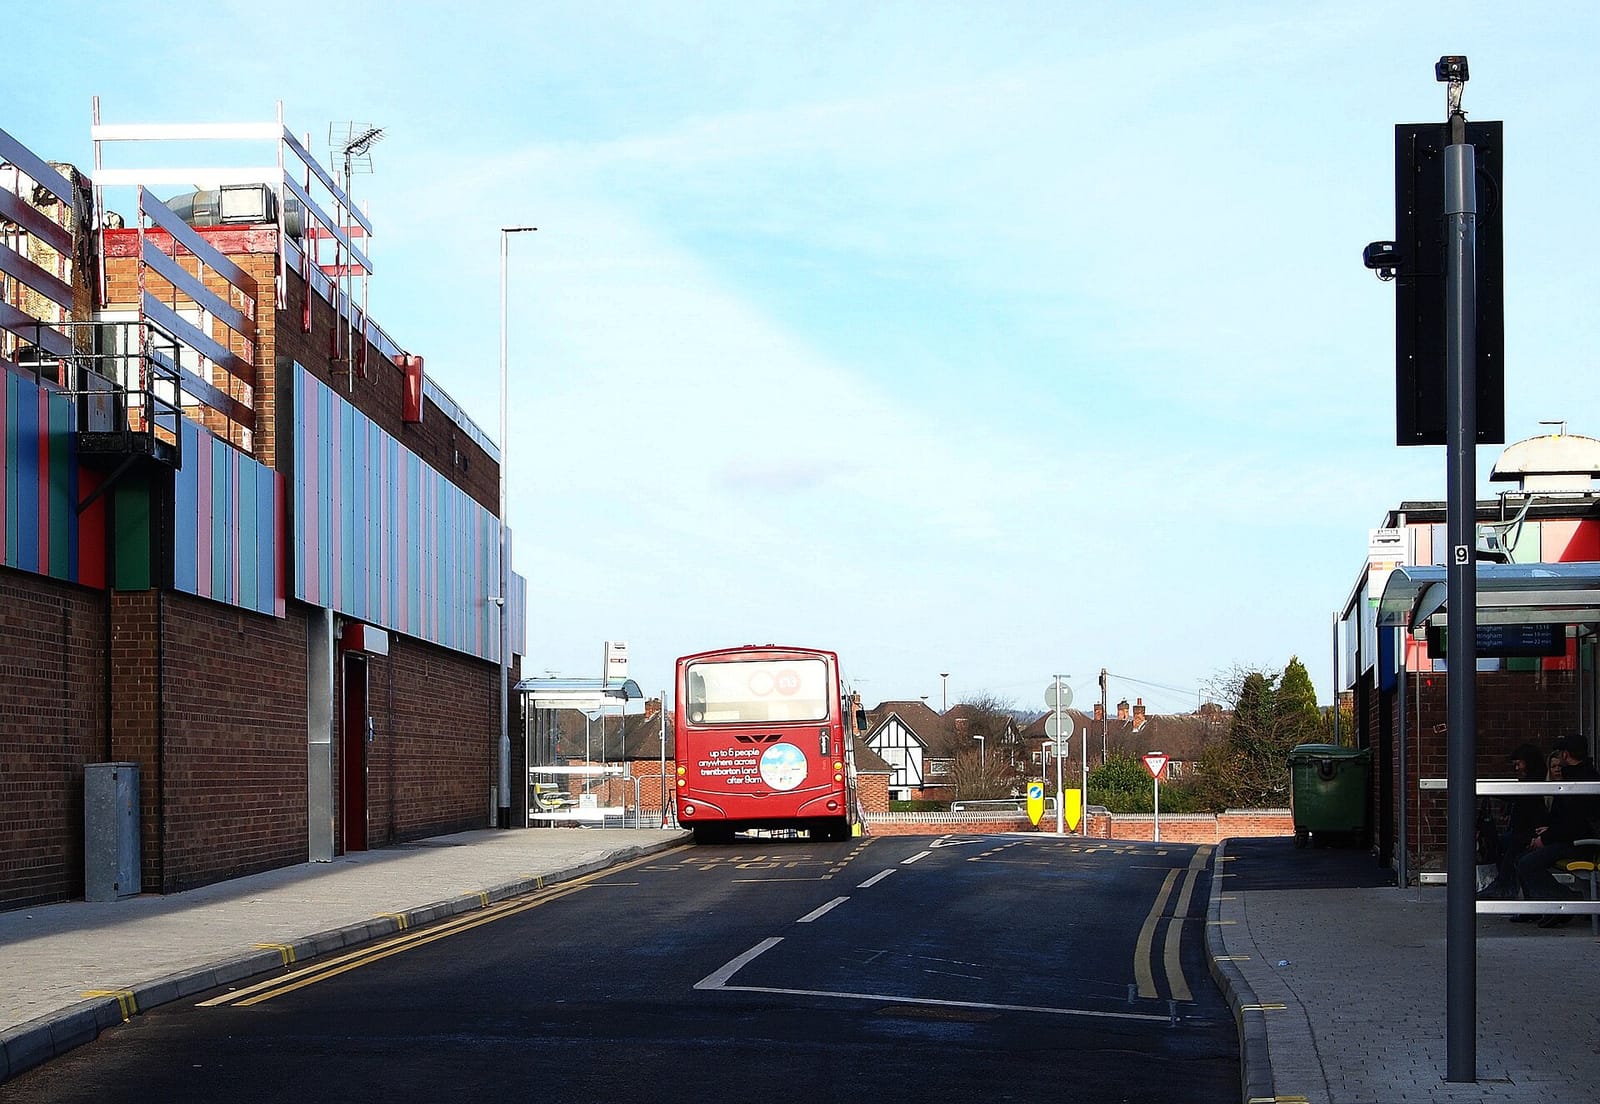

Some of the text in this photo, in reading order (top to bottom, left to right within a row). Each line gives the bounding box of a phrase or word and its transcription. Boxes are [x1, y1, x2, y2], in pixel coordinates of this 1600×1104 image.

[1456, 547, 1467, 562] 9
[709, 751, 720, 759] up
[734, 747, 760, 757] people
[698, 758, 733, 767] anywhere
[700, 766, 758, 776] trentbarton land
[726, 775, 744, 784] after
[679, 854, 814, 864] BUS
[637, 860, 833, 872] STOP
